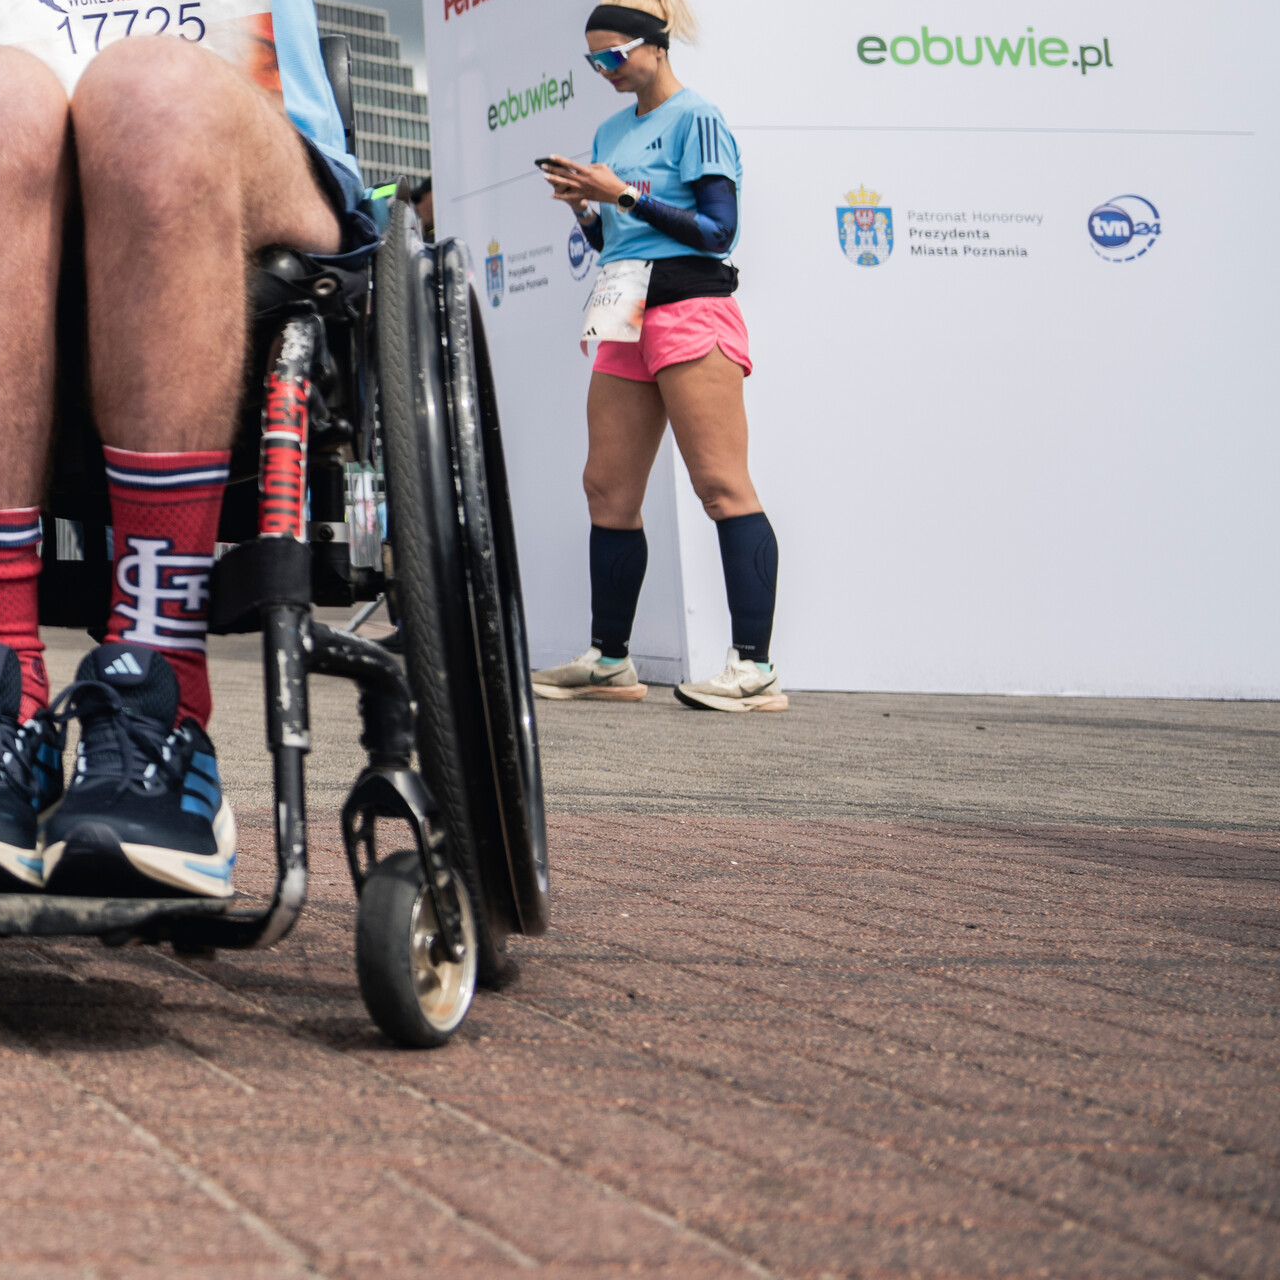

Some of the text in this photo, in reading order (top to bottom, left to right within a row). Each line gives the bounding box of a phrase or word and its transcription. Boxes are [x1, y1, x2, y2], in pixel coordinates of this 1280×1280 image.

[56, 1, 206, 55] 17725
[856, 25, 1114, 75] eobuwie.pl
[487, 70, 574, 132] eobuwie.pl
[907, 210, 1044, 226] Patronat Honorowy
[908, 227, 990, 242] Prezydenta
[910, 244, 1029, 258] Miasta Poznania
